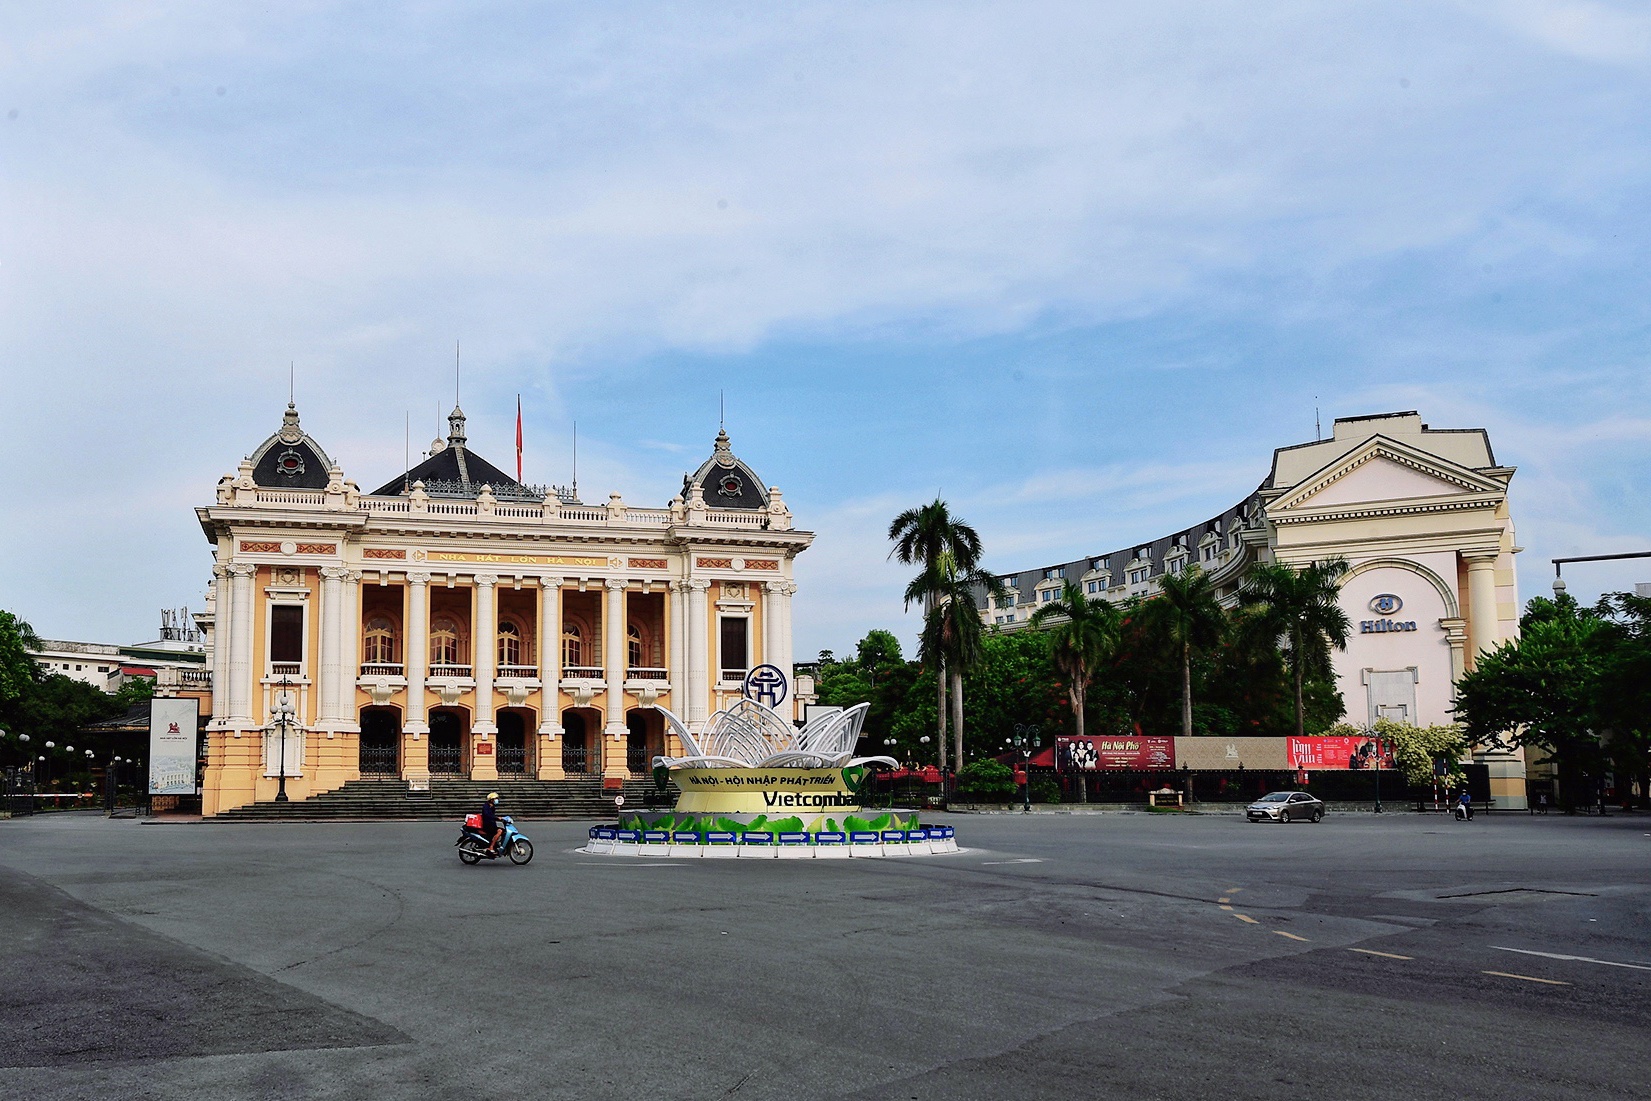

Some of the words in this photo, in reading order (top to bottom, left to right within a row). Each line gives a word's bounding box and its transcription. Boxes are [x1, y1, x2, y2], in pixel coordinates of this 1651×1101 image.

[476, 553, 502, 562] HÁT
[547, 555, 564, 564] HÀ
[1360, 618, 1418, 634] Hilton
[689, 775, 702, 785] HÀ
[701, 775, 720, 787] NỘI
[724, 775, 745, 787] HỘI
[747, 775, 778, 787] NHẬP
[780, 776, 809, 787] PHÁT
